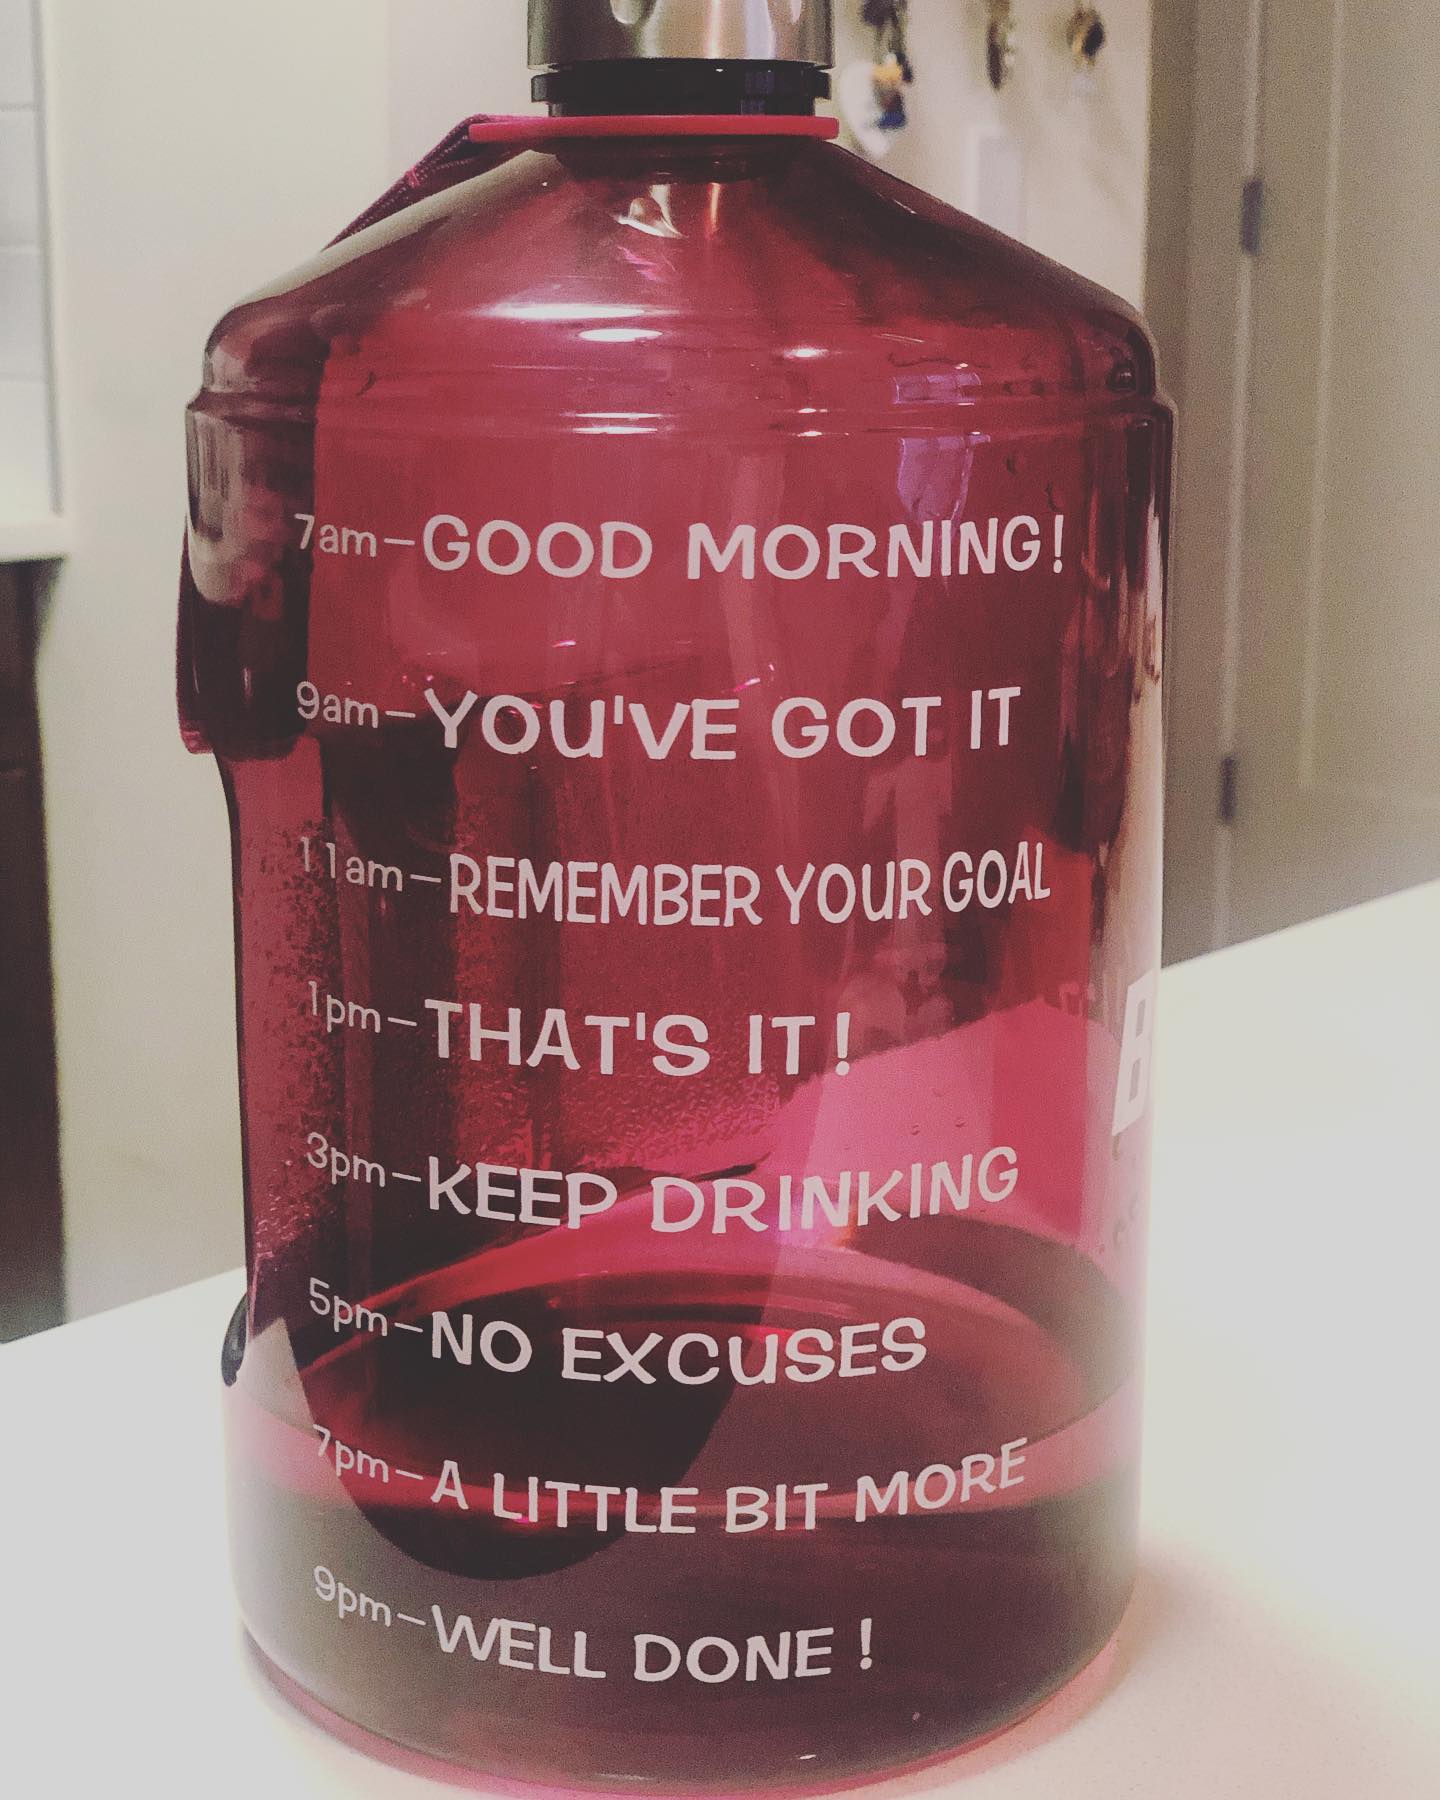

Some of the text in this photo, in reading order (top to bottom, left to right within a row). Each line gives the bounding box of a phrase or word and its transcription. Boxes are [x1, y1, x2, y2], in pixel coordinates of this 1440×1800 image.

[423, 513, 653, 579] GOOD
[423, 687, 741, 761] YOU'VE
[771, 694, 943, 759] GOT
[969, 685, 1022, 750] IT
[449, 852, 764, 928] REMEMBER
[775, 857, 933, 926] YOUR
[942, 840, 1052, 915] GOAL
[423, 998, 711, 1078] THAT'S
[428, 1155, 618, 1230] KEEP
[650, 1145, 1019, 1235] DRINKING
[431, 1310, 533, 1374] NO
[561, 1316, 928, 1387] EXCUSES
[430, 1459, 470, 1511] A
[492, 1472, 698, 1535] LITTLE
[724, 1482, 829, 1535] BIT
[854, 1436, 1029, 1523] MORE
[430, 1603, 607, 1680] WELL
